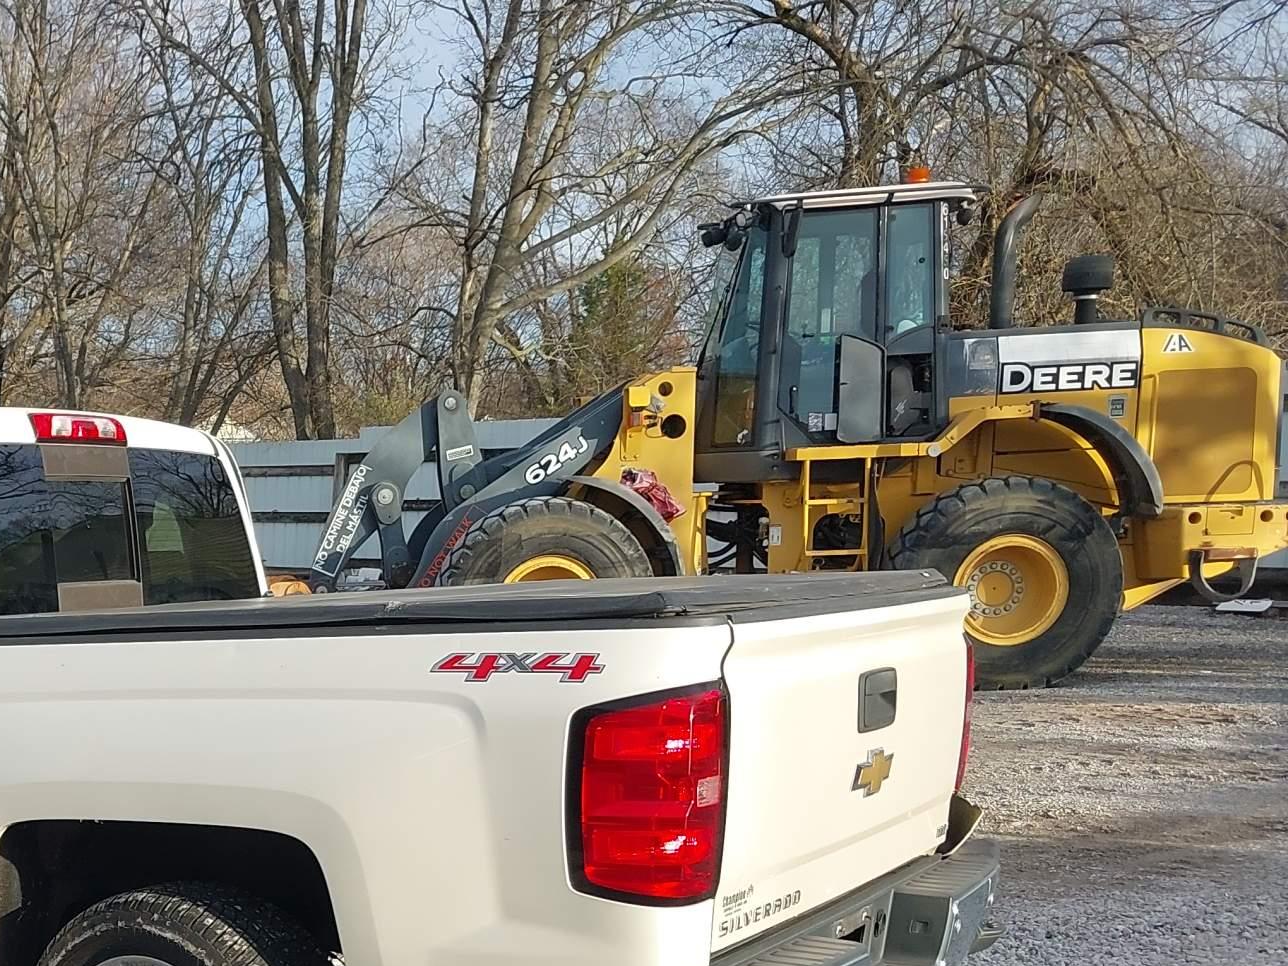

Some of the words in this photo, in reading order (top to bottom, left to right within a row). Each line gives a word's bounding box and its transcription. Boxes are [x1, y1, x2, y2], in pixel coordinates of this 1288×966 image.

[1001, 362, 1138, 393] DEERE
[525, 435, 589, 485] 624J
[315, 551, 328, 569] NO
[324, 508, 349, 550] CAMINE
[342, 466, 367, 508] DEBAJO
[336, 532, 354, 554] DEL
[718, 889, 801, 938] SILVERADO
